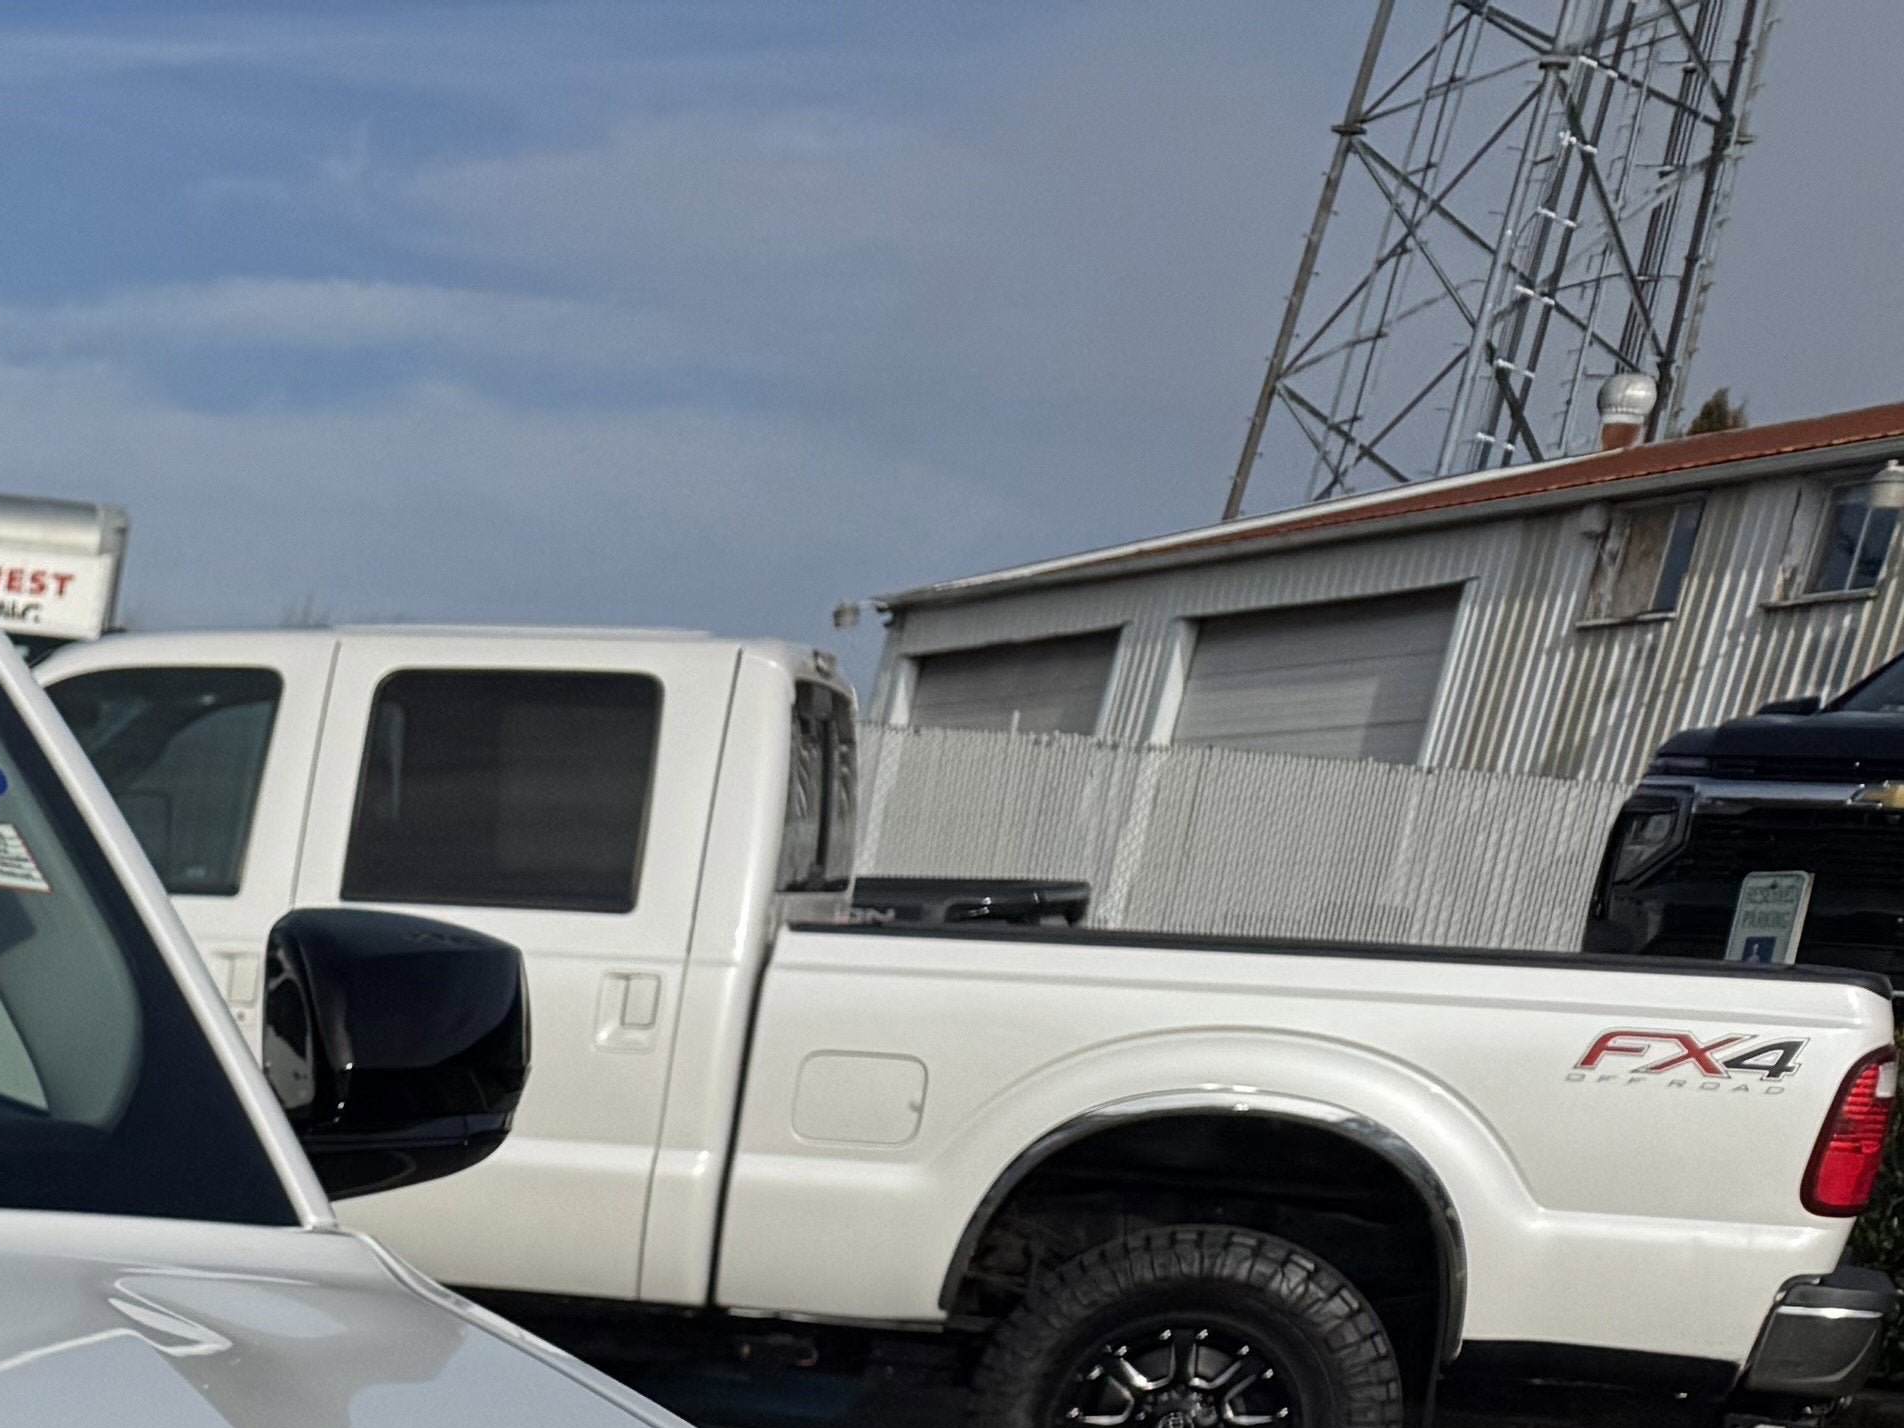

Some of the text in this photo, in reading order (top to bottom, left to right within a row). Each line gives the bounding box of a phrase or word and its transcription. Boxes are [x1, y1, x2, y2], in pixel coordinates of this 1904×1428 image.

[1572, 1026, 1812, 1082] FX4
[1565, 1072, 1786, 1096] OFF ROAD
